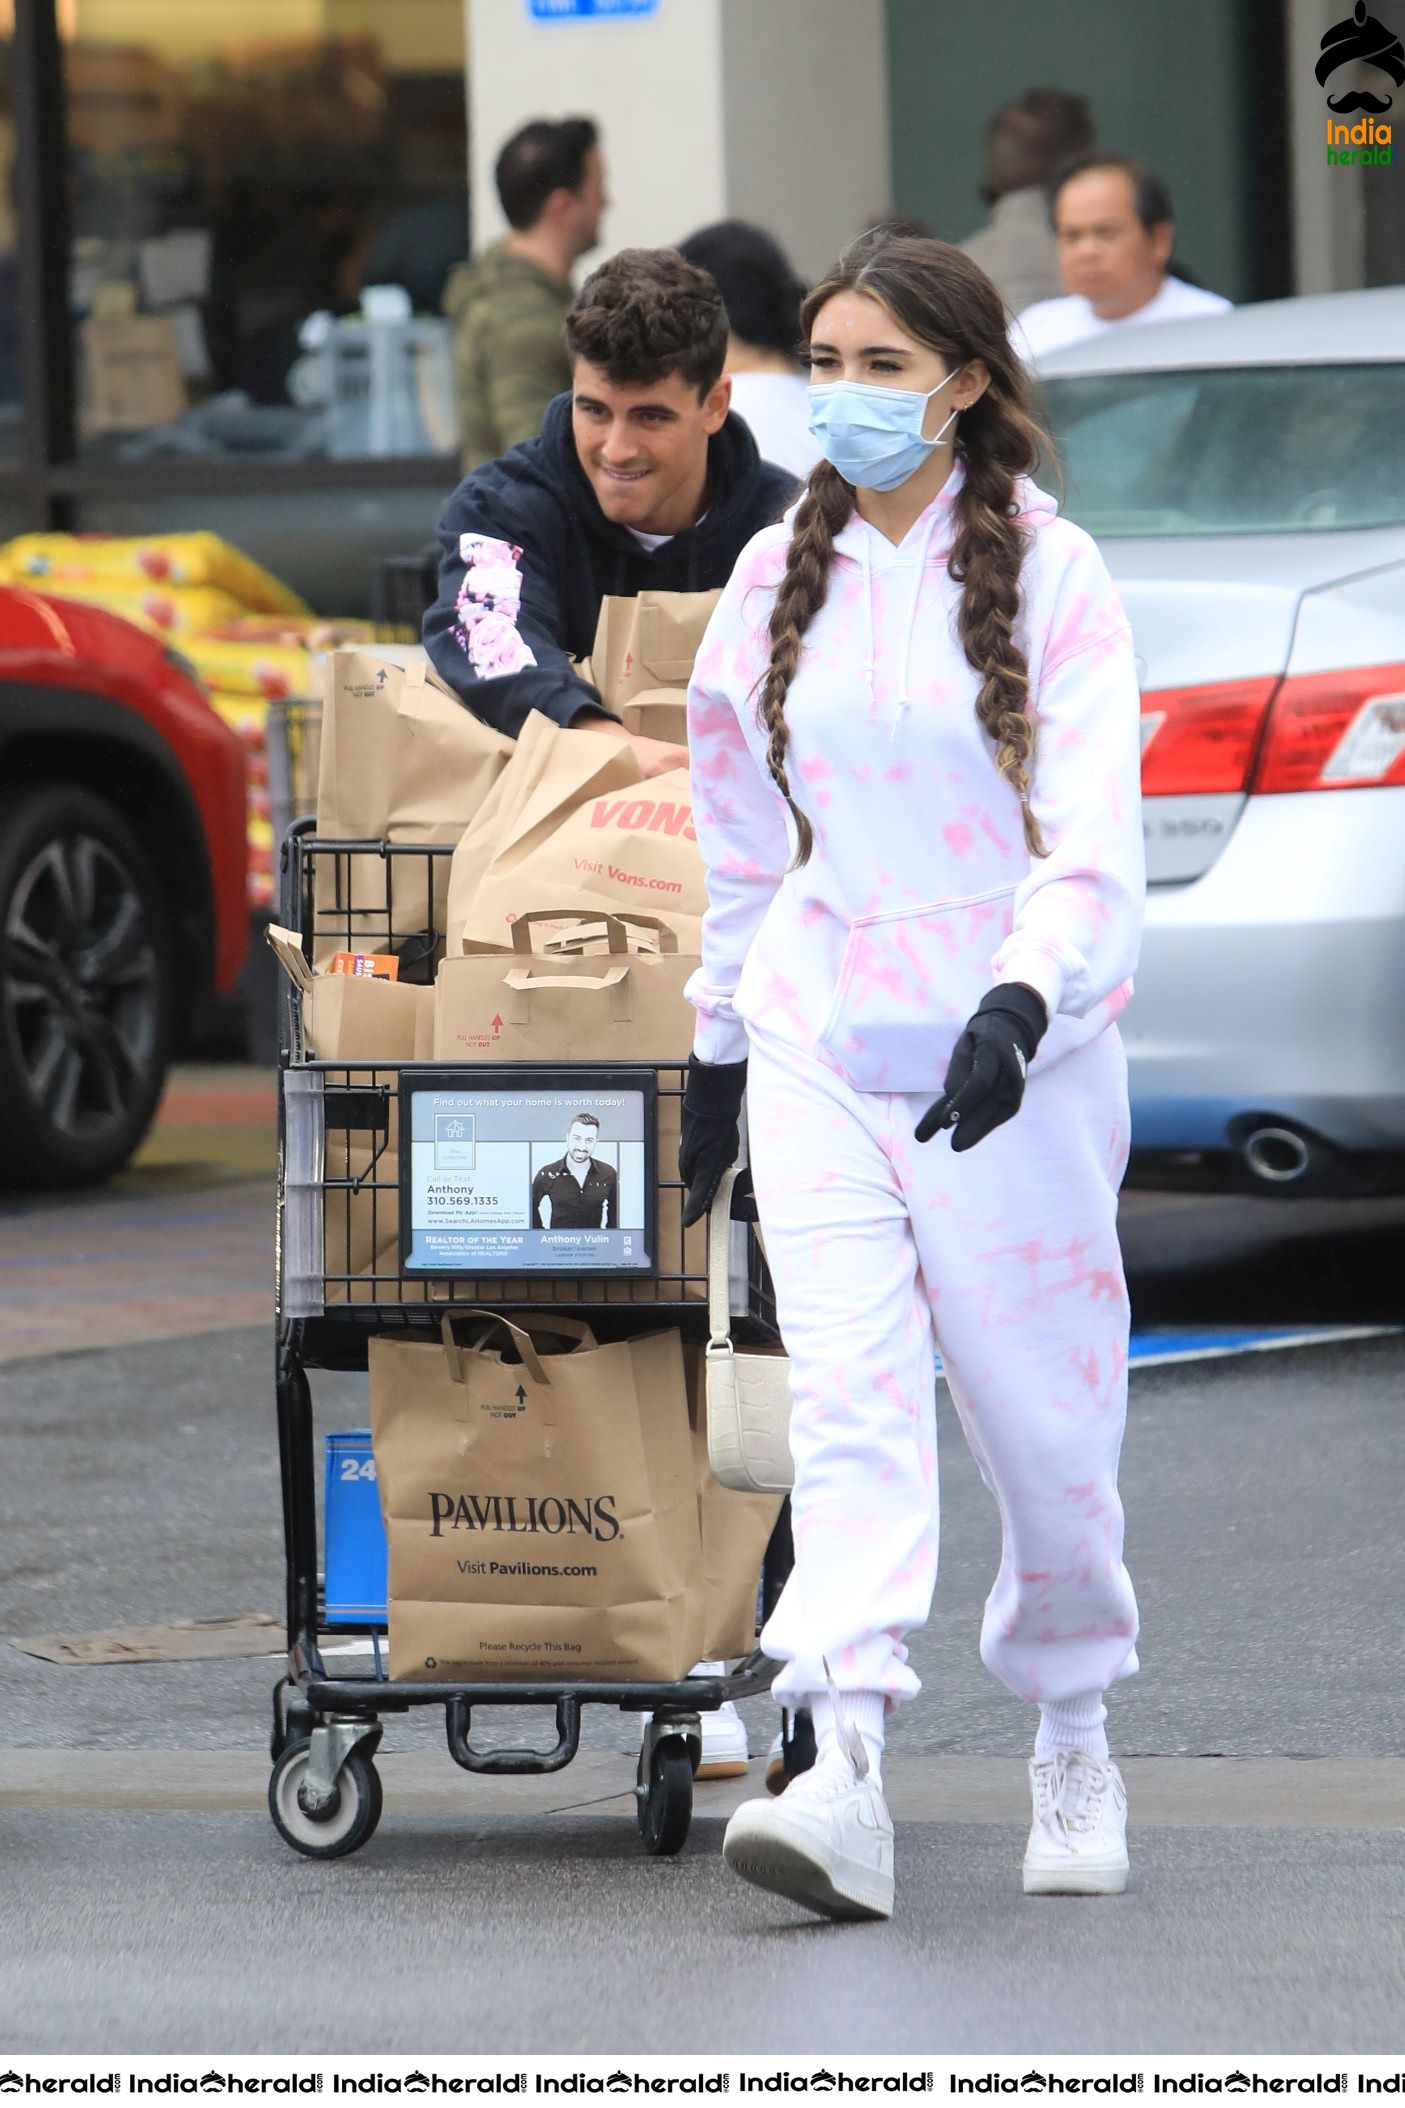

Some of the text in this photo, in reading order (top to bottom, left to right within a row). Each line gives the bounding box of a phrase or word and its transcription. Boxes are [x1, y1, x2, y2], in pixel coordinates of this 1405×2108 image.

[573, 857, 683, 894] Visit Vons.com
[433, 1098, 625, 1109] Find out what your home is worth today!
[427, 1175, 441, 1183] Call
[454, 1175, 471, 1183] Text
[427, 1185, 474, 1195] Anthony
[427, 1196, 499, 1206] 310.569.1335
[540, 1234, 610, 1245] Anthony Vulin
[341, 1459, 376, 1481] 24
[457, 1560, 598, 1577] Visit Pavilions.com
[479, 1641, 582, 1653] Please Recycle This Bag
